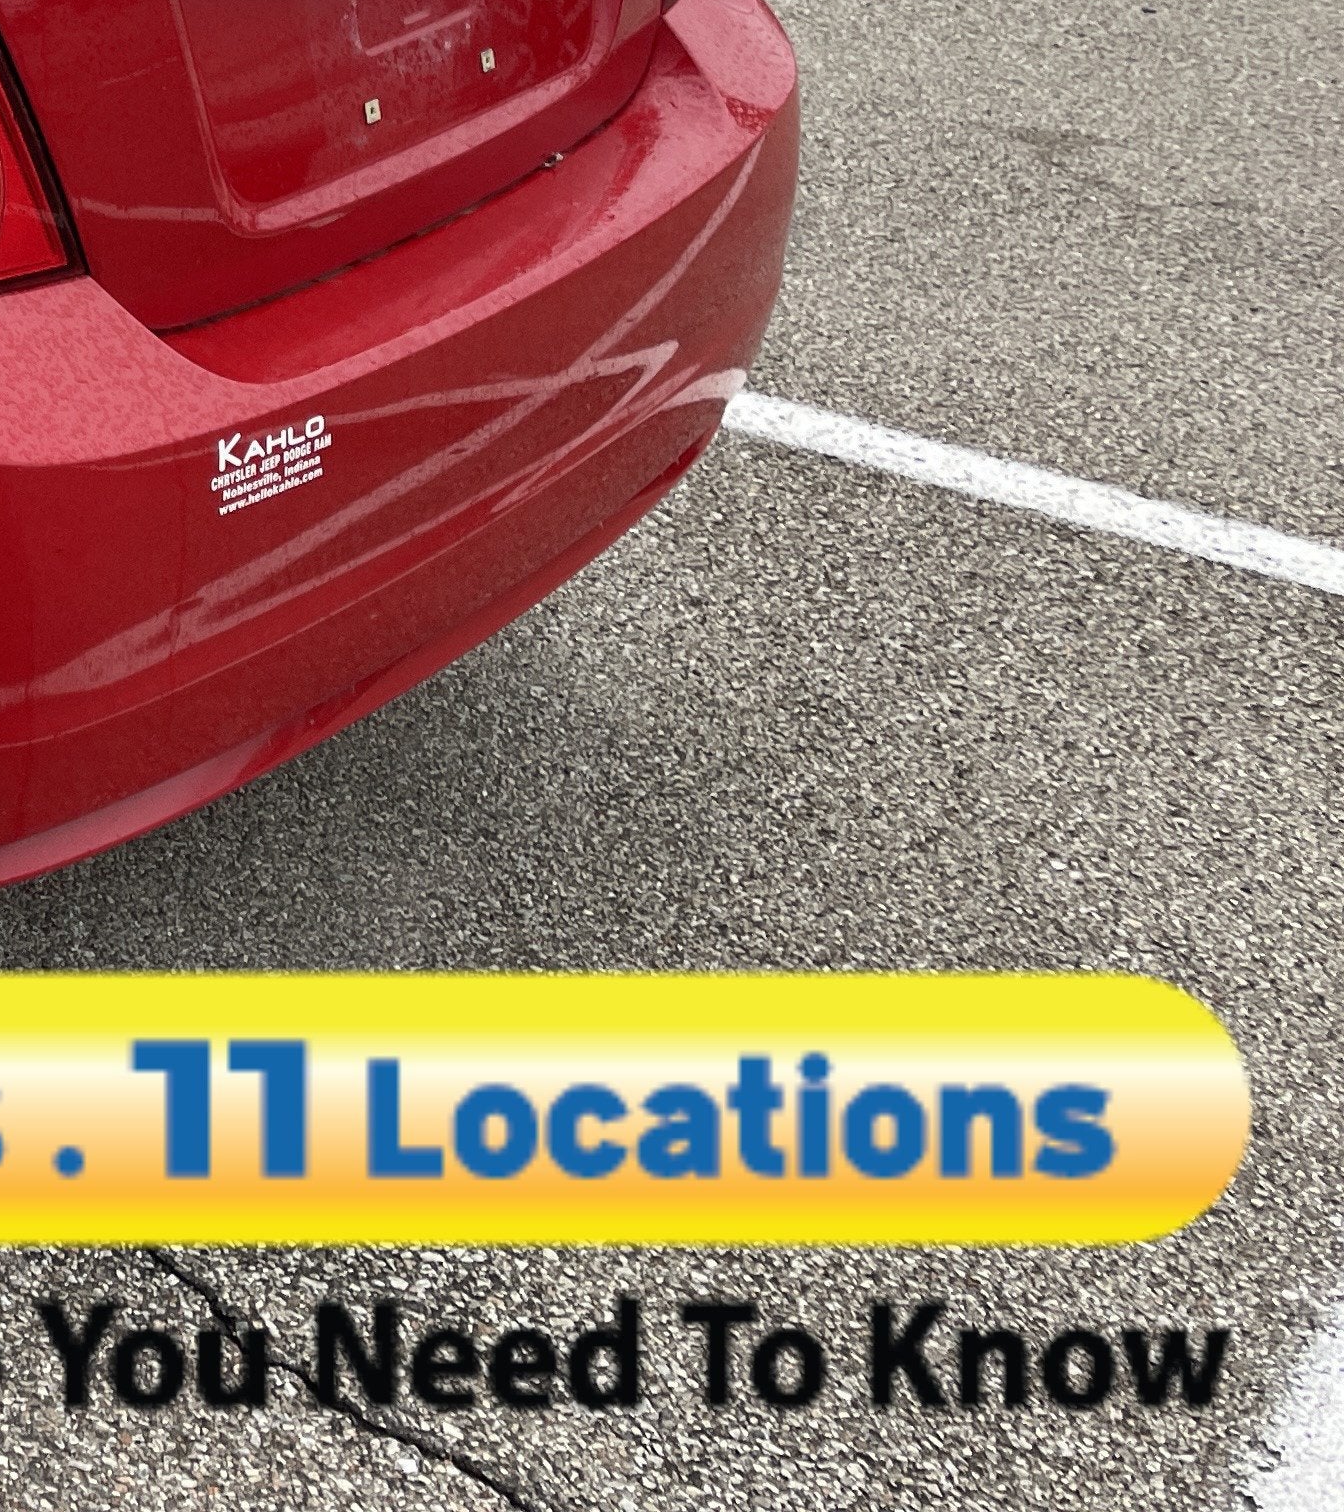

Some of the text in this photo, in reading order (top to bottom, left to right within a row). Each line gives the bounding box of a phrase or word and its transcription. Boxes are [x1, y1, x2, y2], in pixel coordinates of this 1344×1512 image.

[211, 433, 332, 491] CHRYSLER JEEP DODGE RAM
[218, 415, 325, 472] KAHLO
[284, 455, 321, 477] Indiana
[218, 467, 324, 516] www.hellokahlo.com
